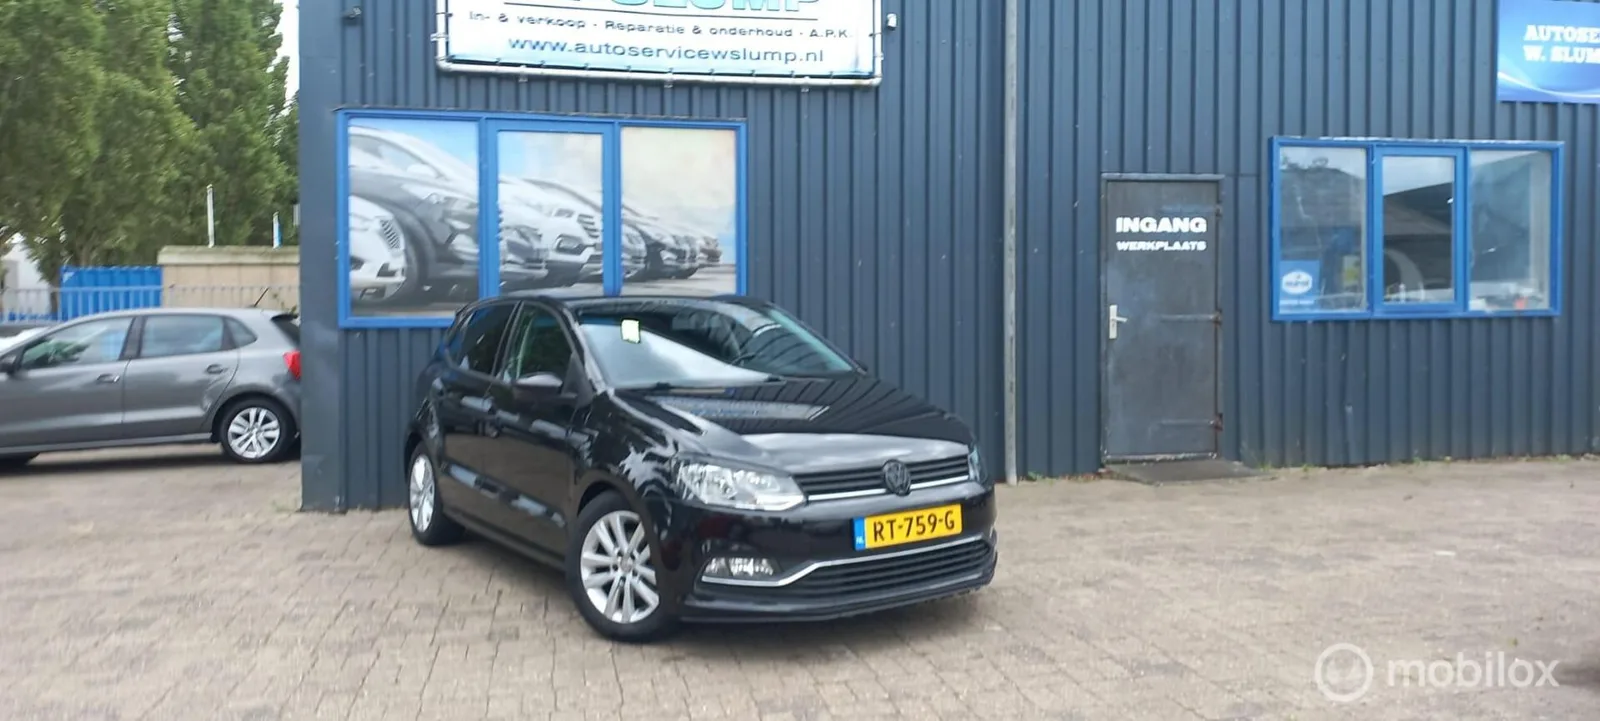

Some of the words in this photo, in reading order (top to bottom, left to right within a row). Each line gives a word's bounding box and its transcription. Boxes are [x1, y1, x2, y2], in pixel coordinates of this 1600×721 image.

[498, 13, 509, 23] &
[516, 15, 586, 29] verkoop
[605, 20, 685, 34] Reparatie
[692, 25, 702, 35] &
[709, 27, 793, 37] onderhoud
[508, 38, 824, 64] www.autoservicewslump.nl
[1522, 45, 1547, 62] W.
[1115, 217, 1207, 233] INGANG
[1116, 240, 1207, 251] WERKPLAATS
[873, 510, 955, 542] RT-759-G
